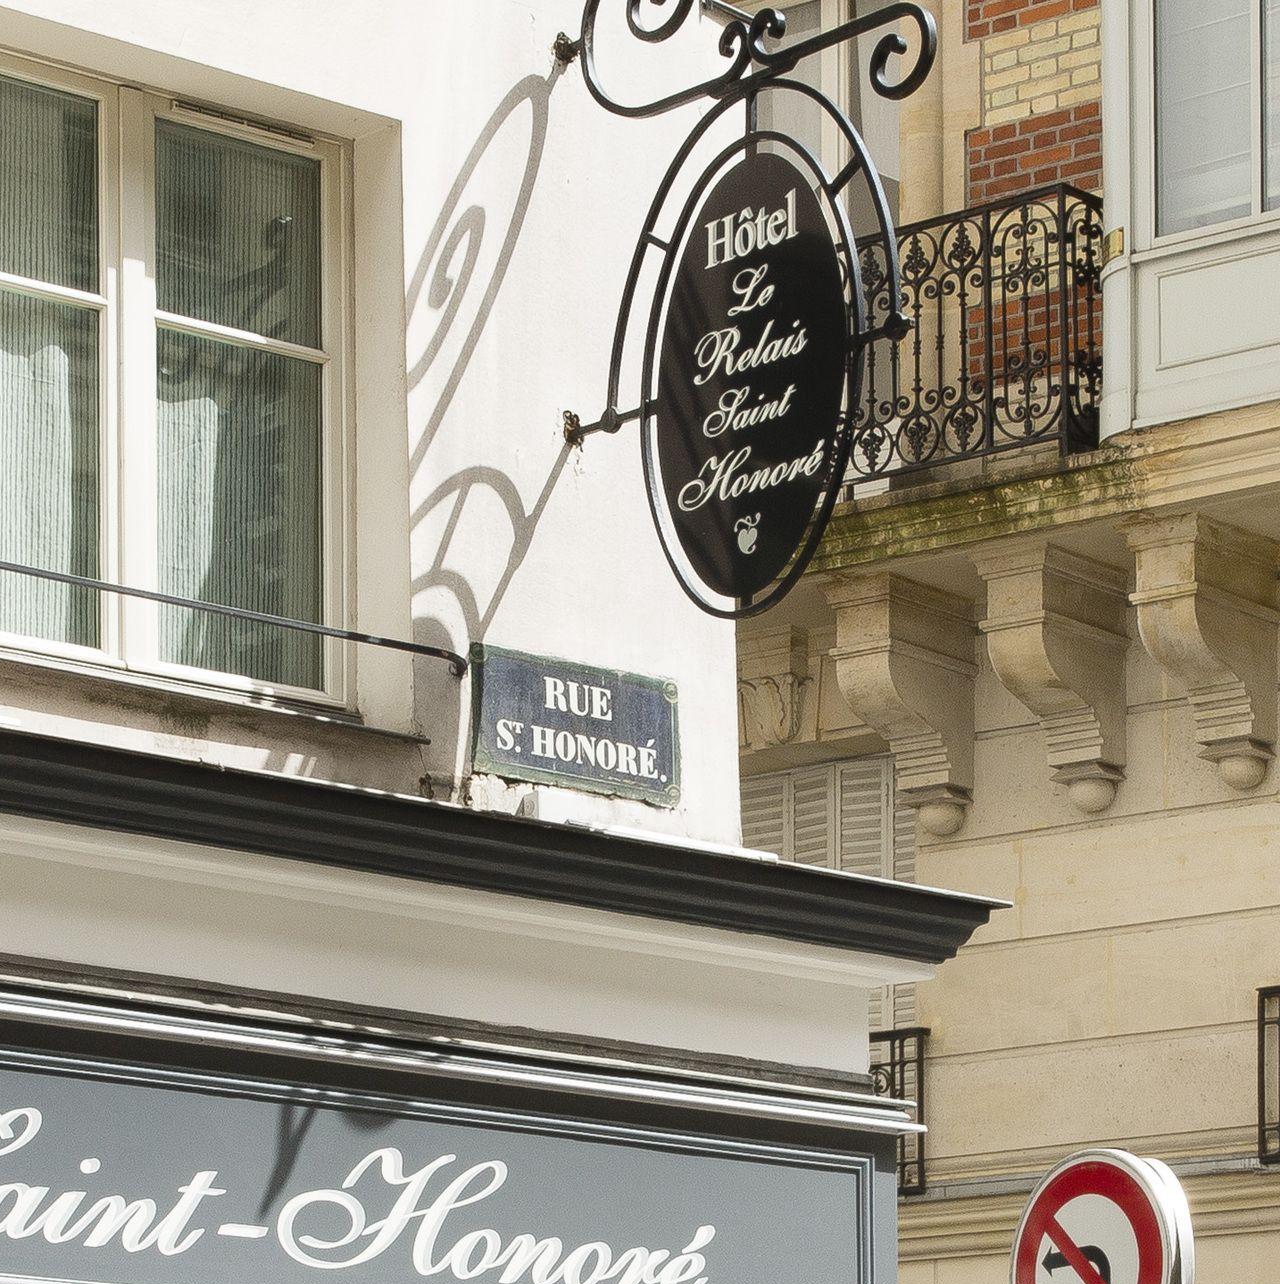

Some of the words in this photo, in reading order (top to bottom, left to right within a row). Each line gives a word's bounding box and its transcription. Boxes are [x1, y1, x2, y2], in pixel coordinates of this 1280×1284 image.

[703, 188, 800, 270] Hôtel
[727, 263, 774, 316] Le
[694, 319, 809, 385] Relais
[703, 384, 797, 438] Saint
[677, 438, 825, 512] Honoré
[543, 676, 613, 721] RUE
[530, 738, 668, 783] HONORÉ.
